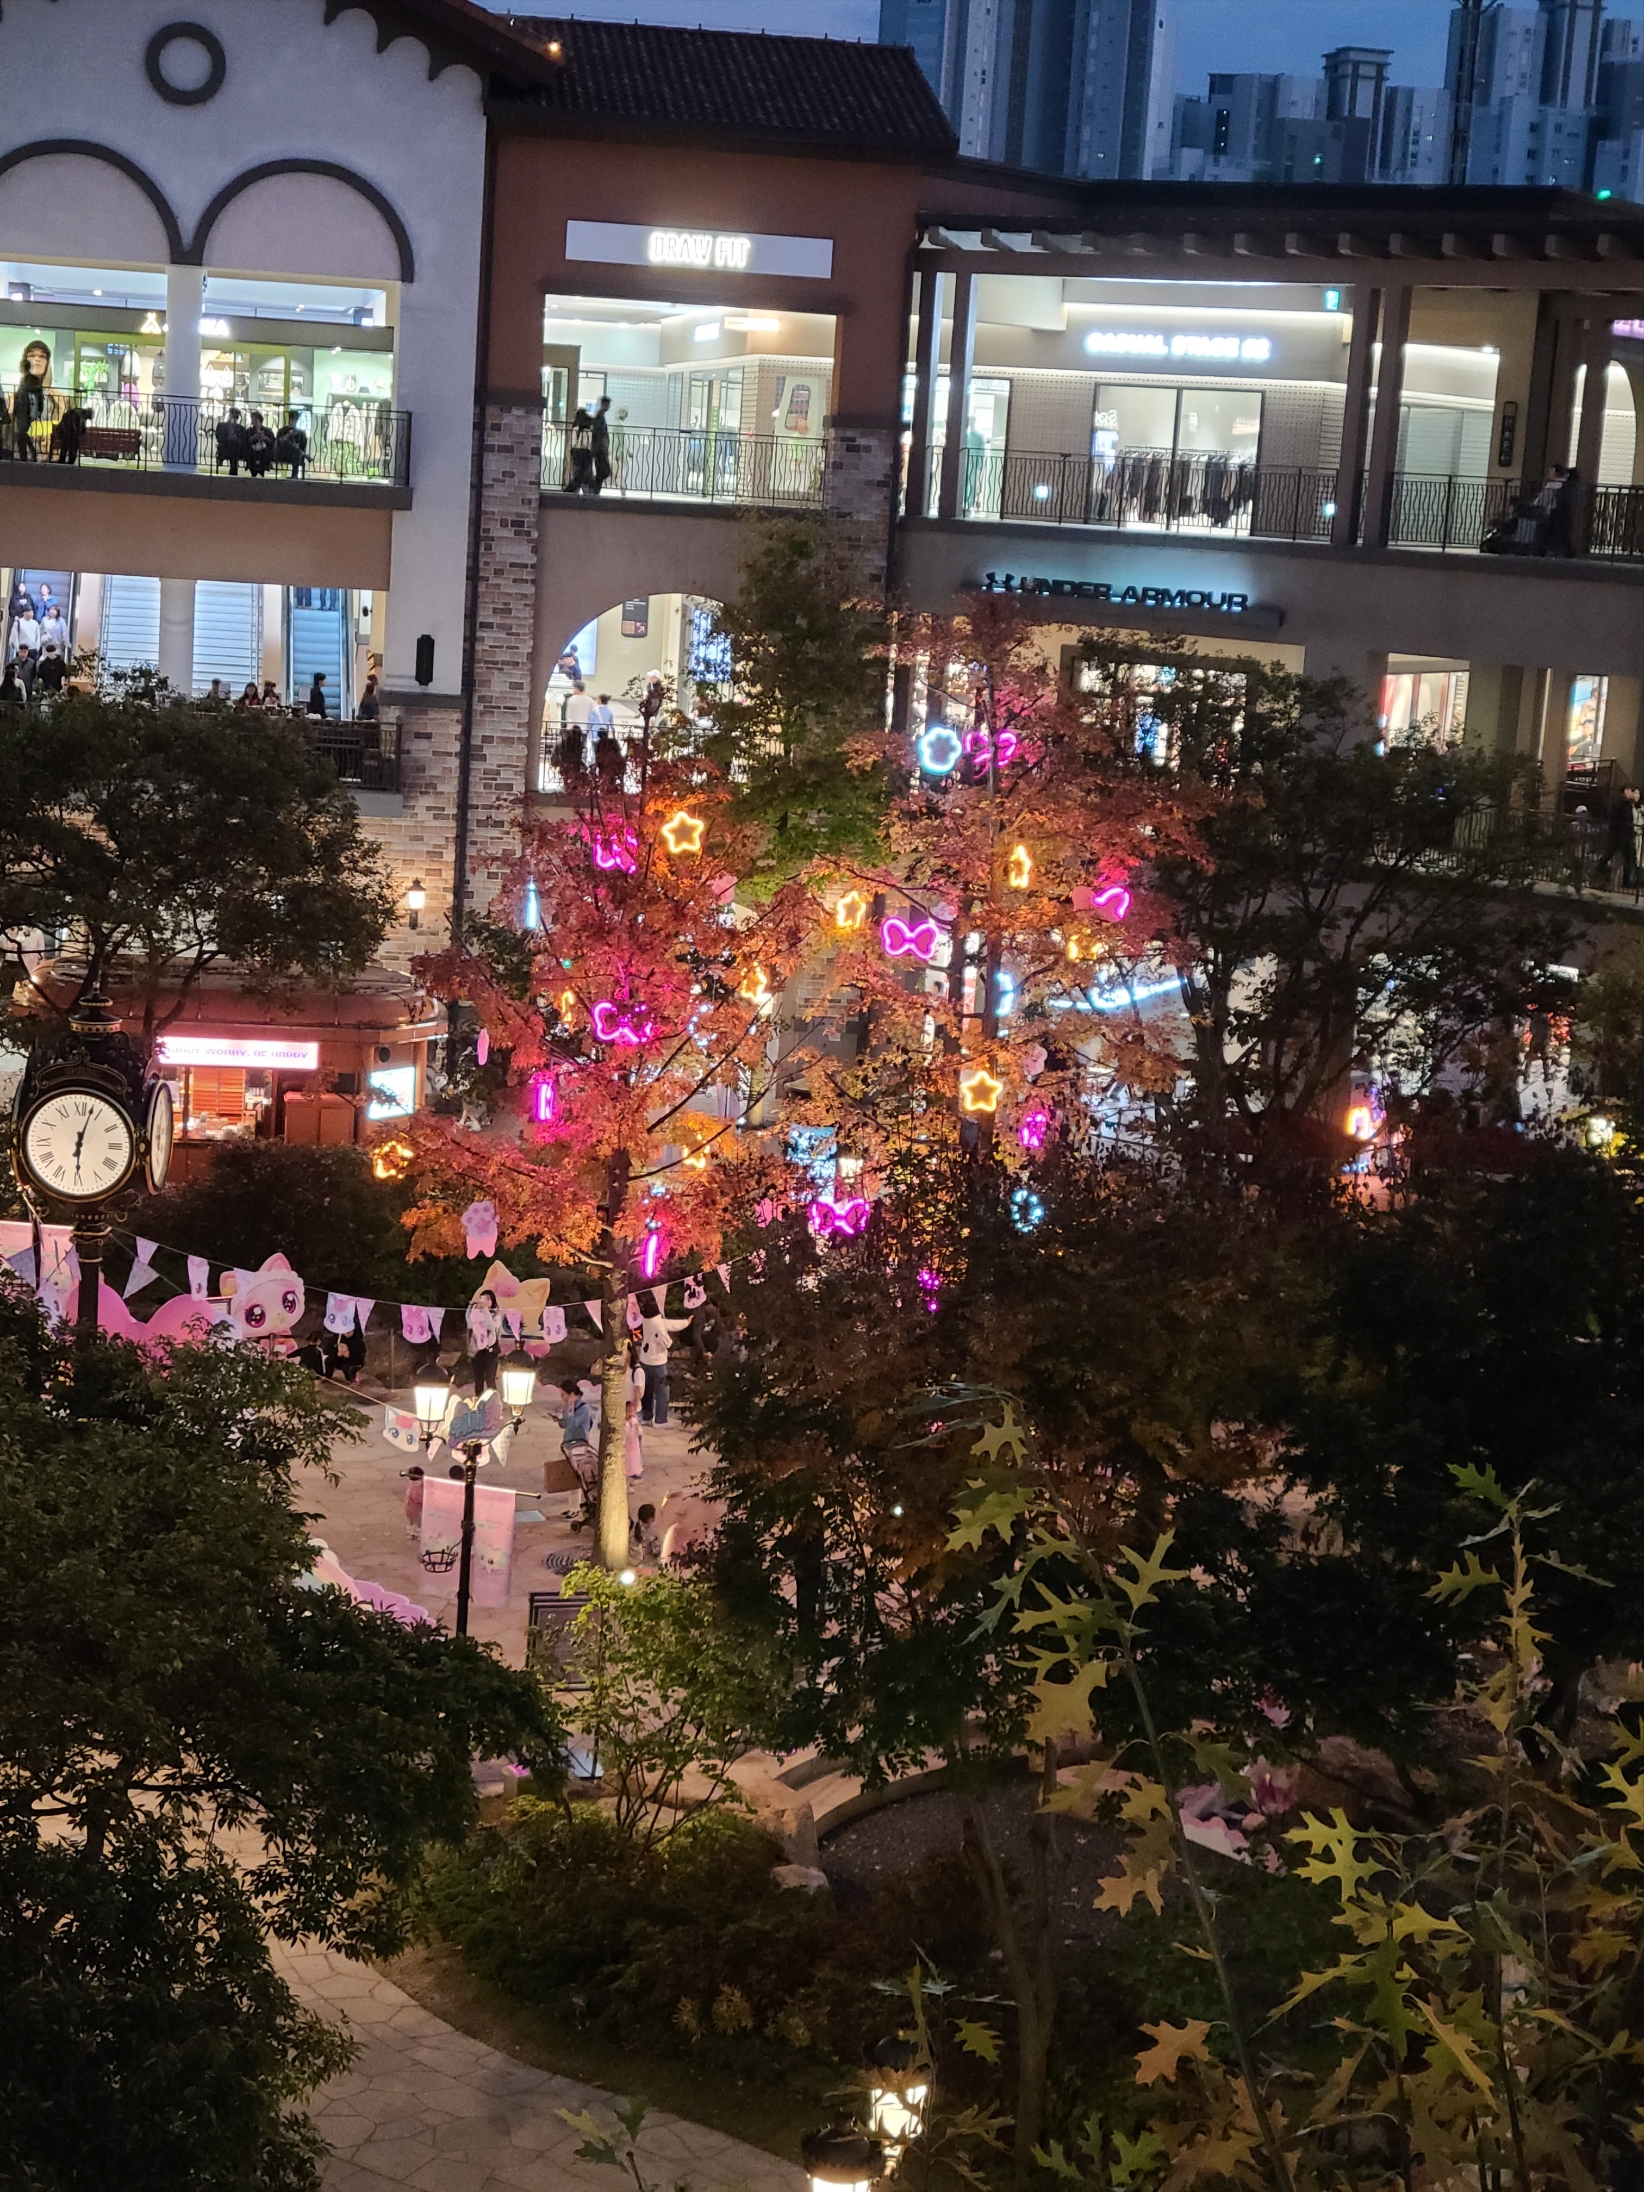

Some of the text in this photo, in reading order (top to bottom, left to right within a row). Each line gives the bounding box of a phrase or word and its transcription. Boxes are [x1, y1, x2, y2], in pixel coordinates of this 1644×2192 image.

[652, 234, 750, 266] DRAW FIT
[1020, 576, 1249, 612] UNDER ARMOUR
[253, 1050, 267, 1058] BE
[271, 1051, 308, 1059] HAPPY
